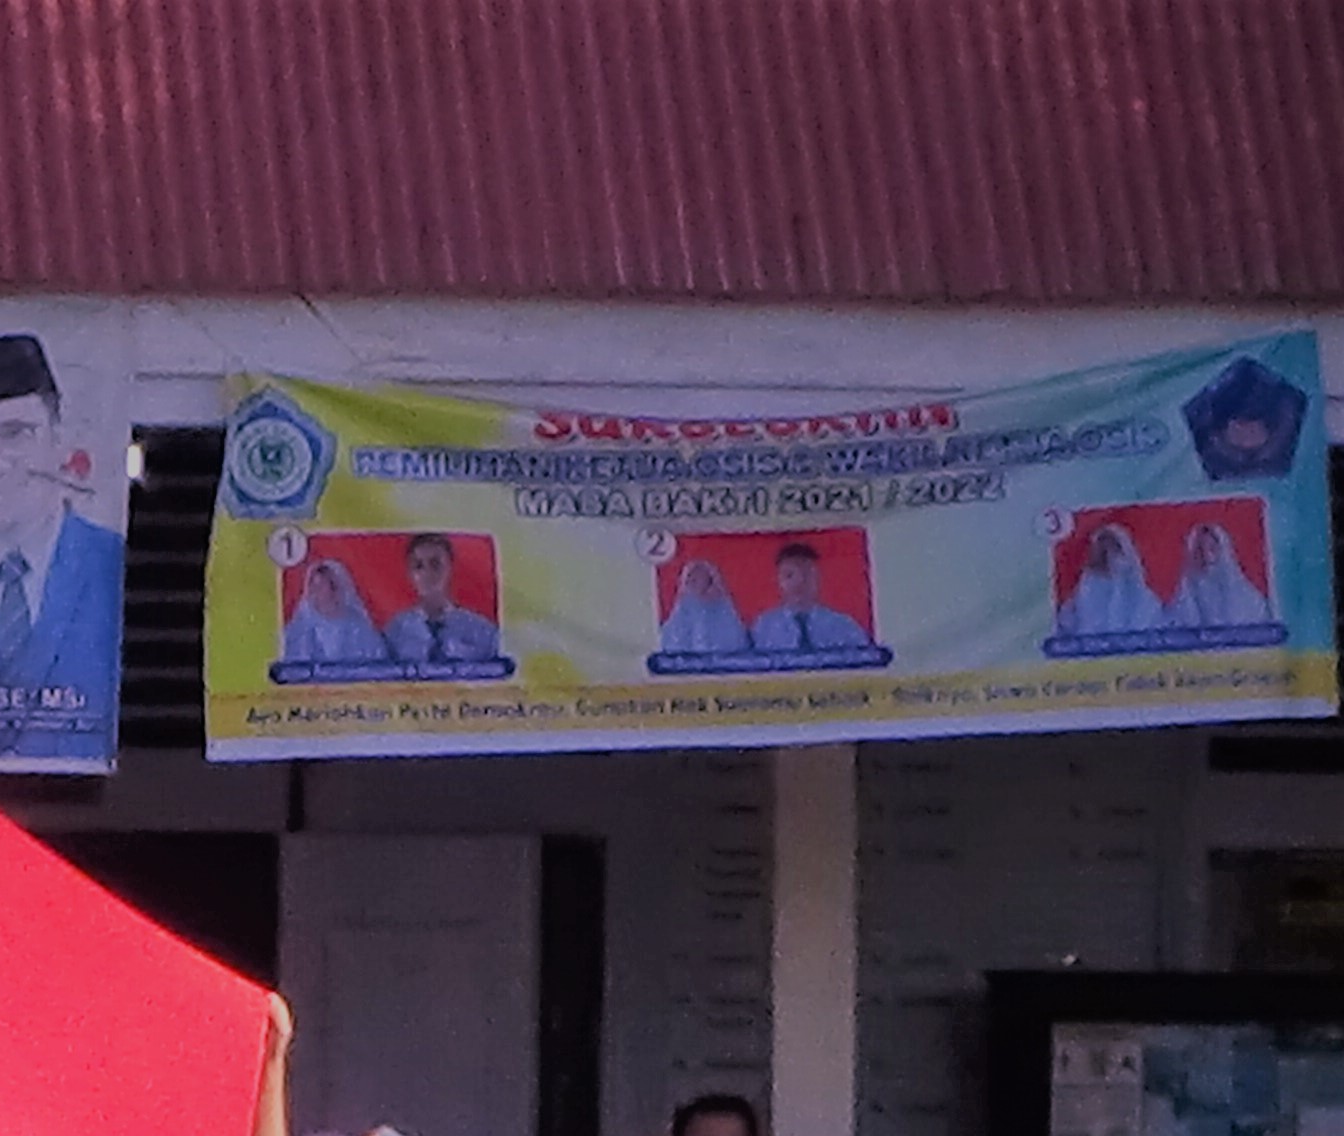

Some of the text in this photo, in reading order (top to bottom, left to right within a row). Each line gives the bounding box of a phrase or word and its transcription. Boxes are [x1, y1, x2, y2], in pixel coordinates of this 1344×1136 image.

[1044, 509, 1061, 534] 3
[282, 533, 296, 558] 1
[647, 533, 666, 557] 2
